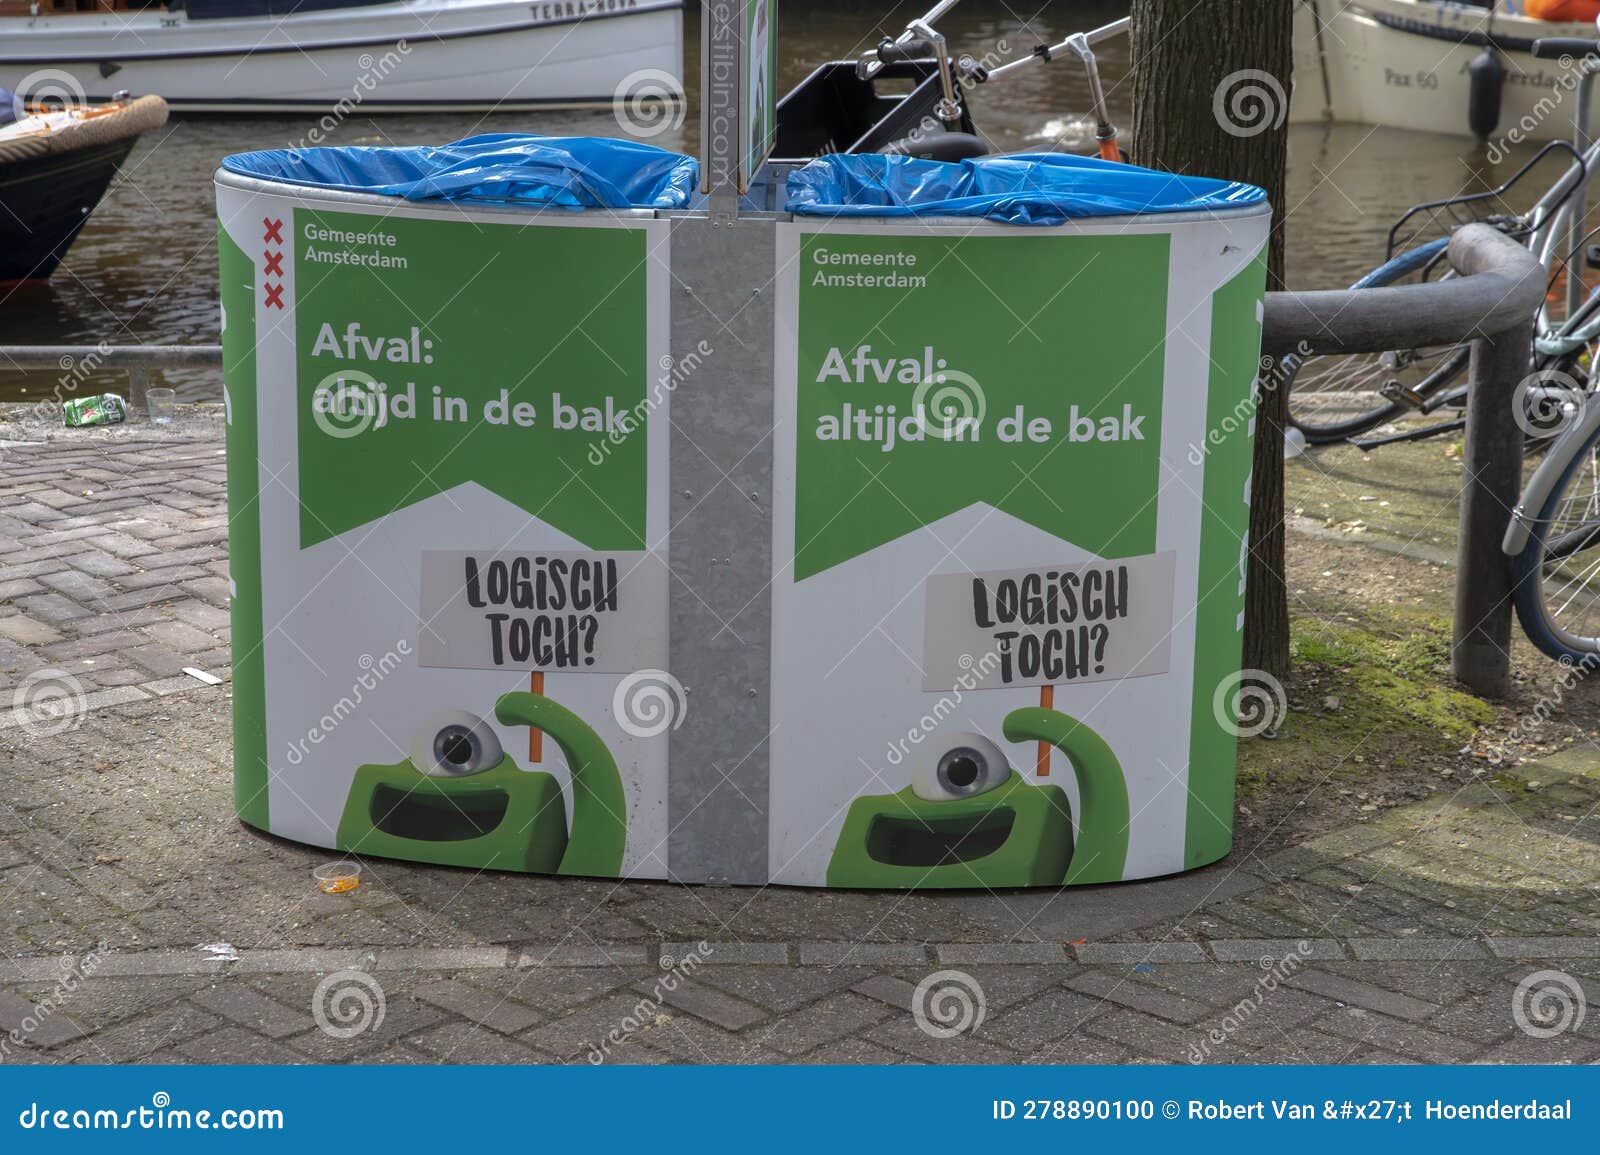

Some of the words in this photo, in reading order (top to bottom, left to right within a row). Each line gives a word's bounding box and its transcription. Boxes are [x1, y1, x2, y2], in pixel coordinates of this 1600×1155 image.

[304, 223, 397, 246] Gemeente
[304, 245, 408, 269] Amsterdam
[812, 248, 917, 267] Gemeente
[812, 270, 927, 288] Amsterdam
[311, 322, 434, 365] Afval:
[815, 345, 948, 384] Afval:
[313, 378, 416, 432] altijd
[432, 385, 468, 423] in
[483, 388, 537, 427] de
[552, 392, 630, 434] bak
[815, 402, 926, 453] altijd
[943, 405, 980, 442] in
[996, 405, 1053, 443] de
[1069, 403, 1146, 442] bak
[485, 613, 599, 668] TOCH?
[993, 623, 1109, 684] TOCH?
